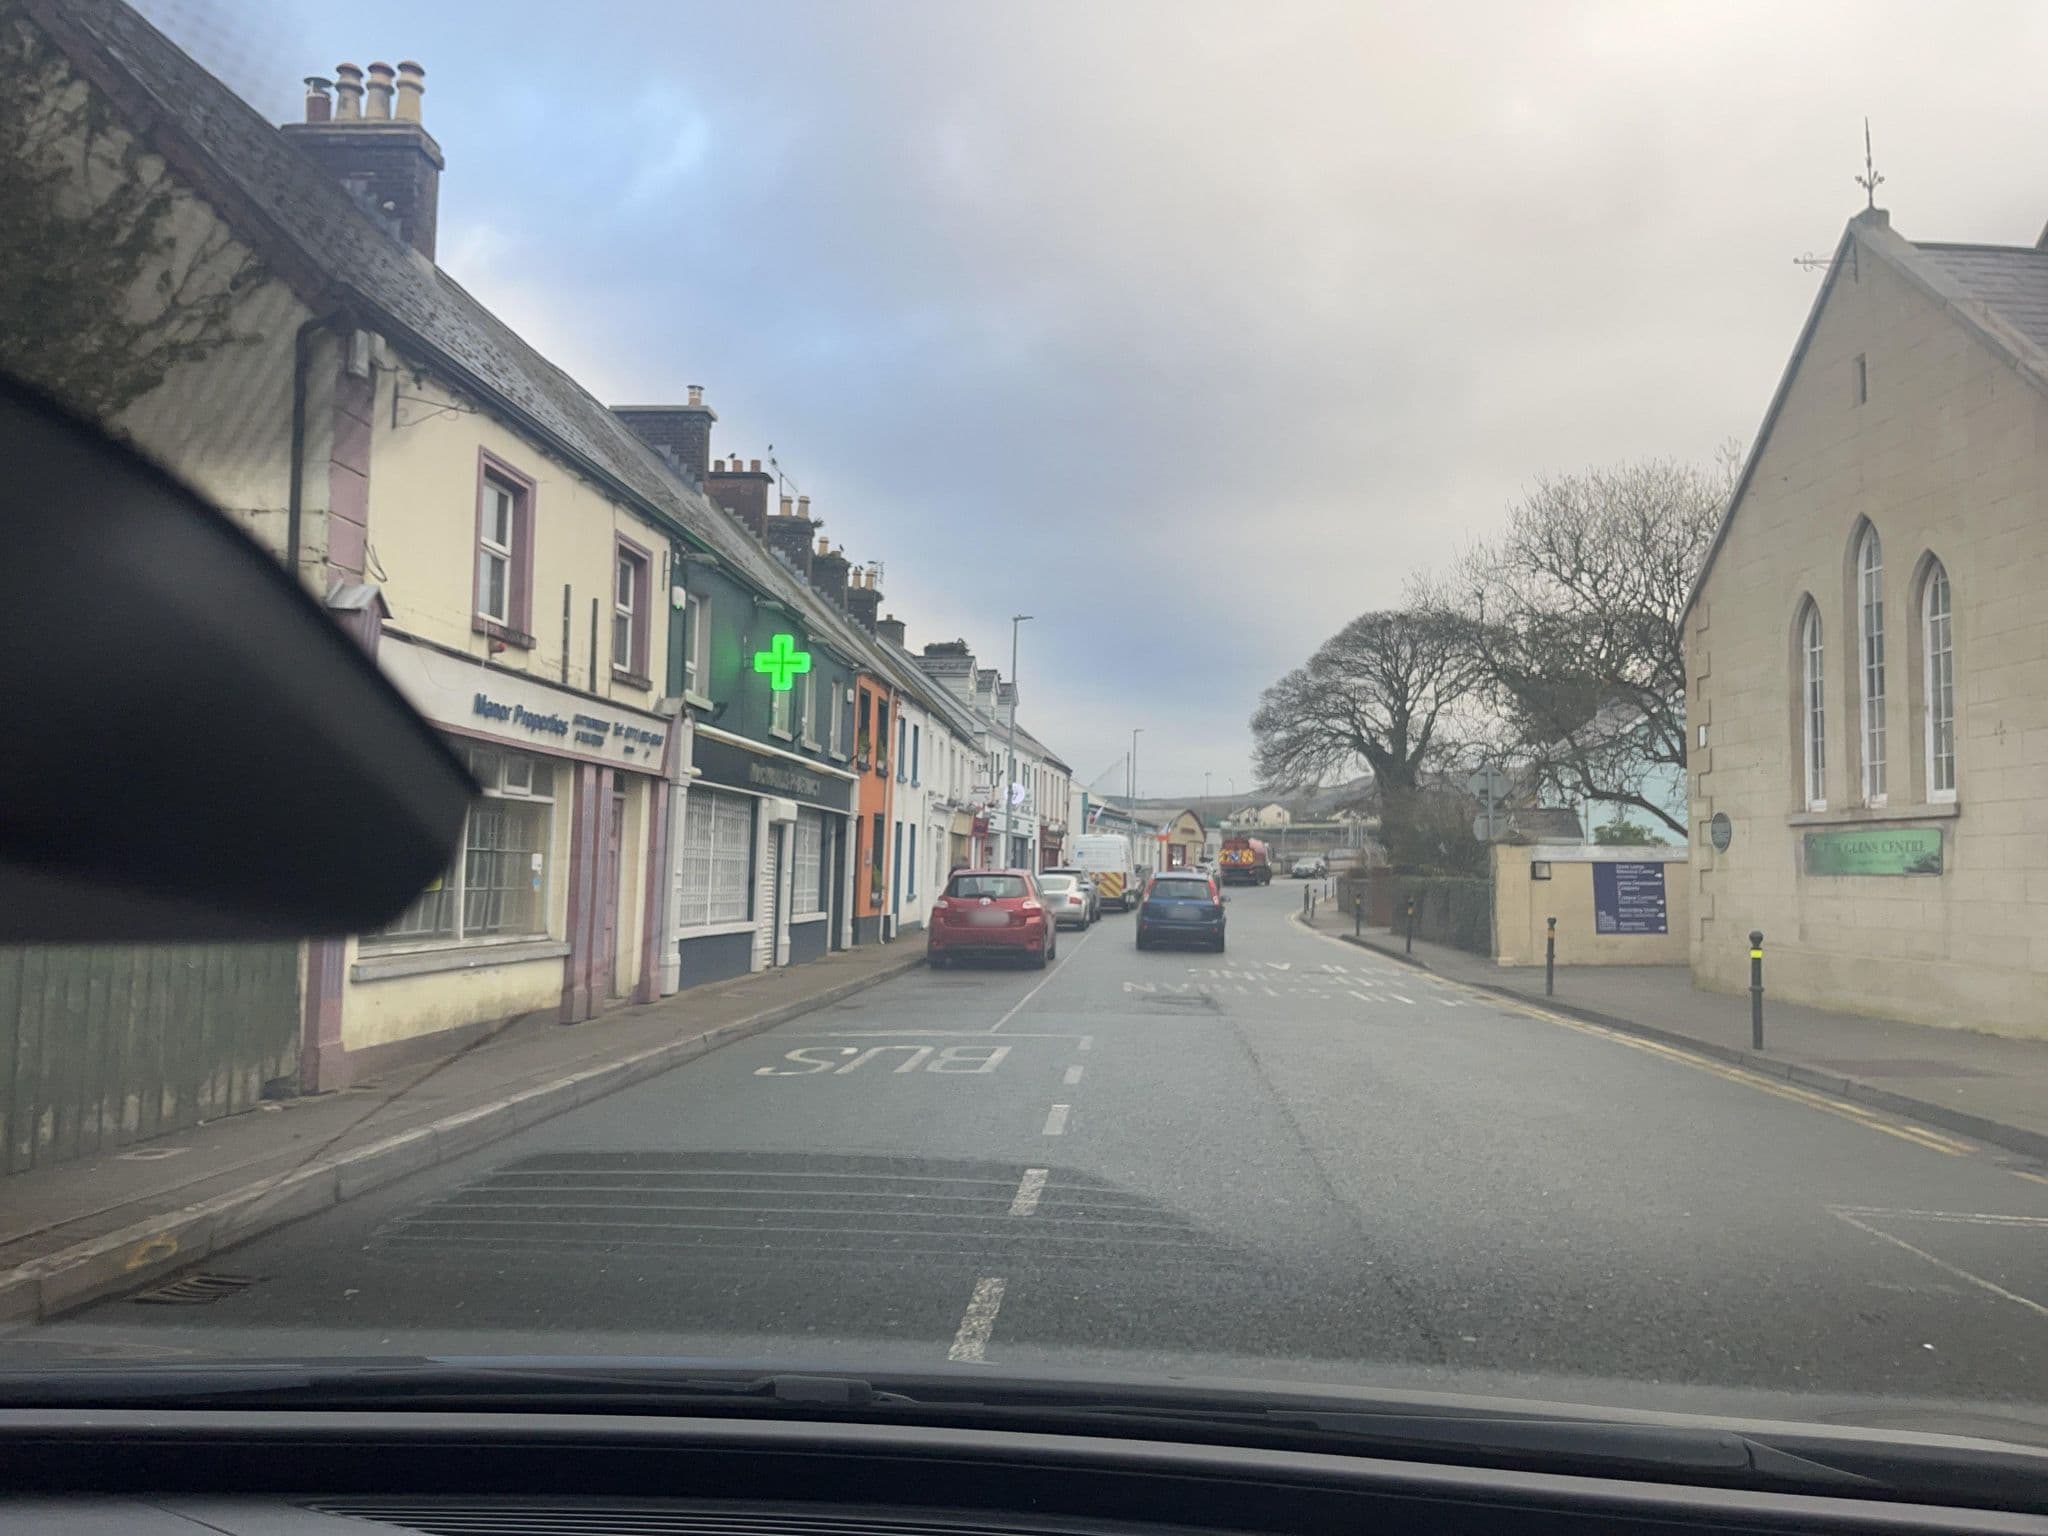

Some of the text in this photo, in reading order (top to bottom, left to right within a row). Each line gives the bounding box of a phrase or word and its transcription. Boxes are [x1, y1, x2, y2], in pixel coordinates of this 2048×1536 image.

[473, 692, 512, 721] Manor
[513, 703, 568, 736] Properties
[1881, 839, 1924, 853] CENTRE
[752, 1045, 1012, 1075] BUS
